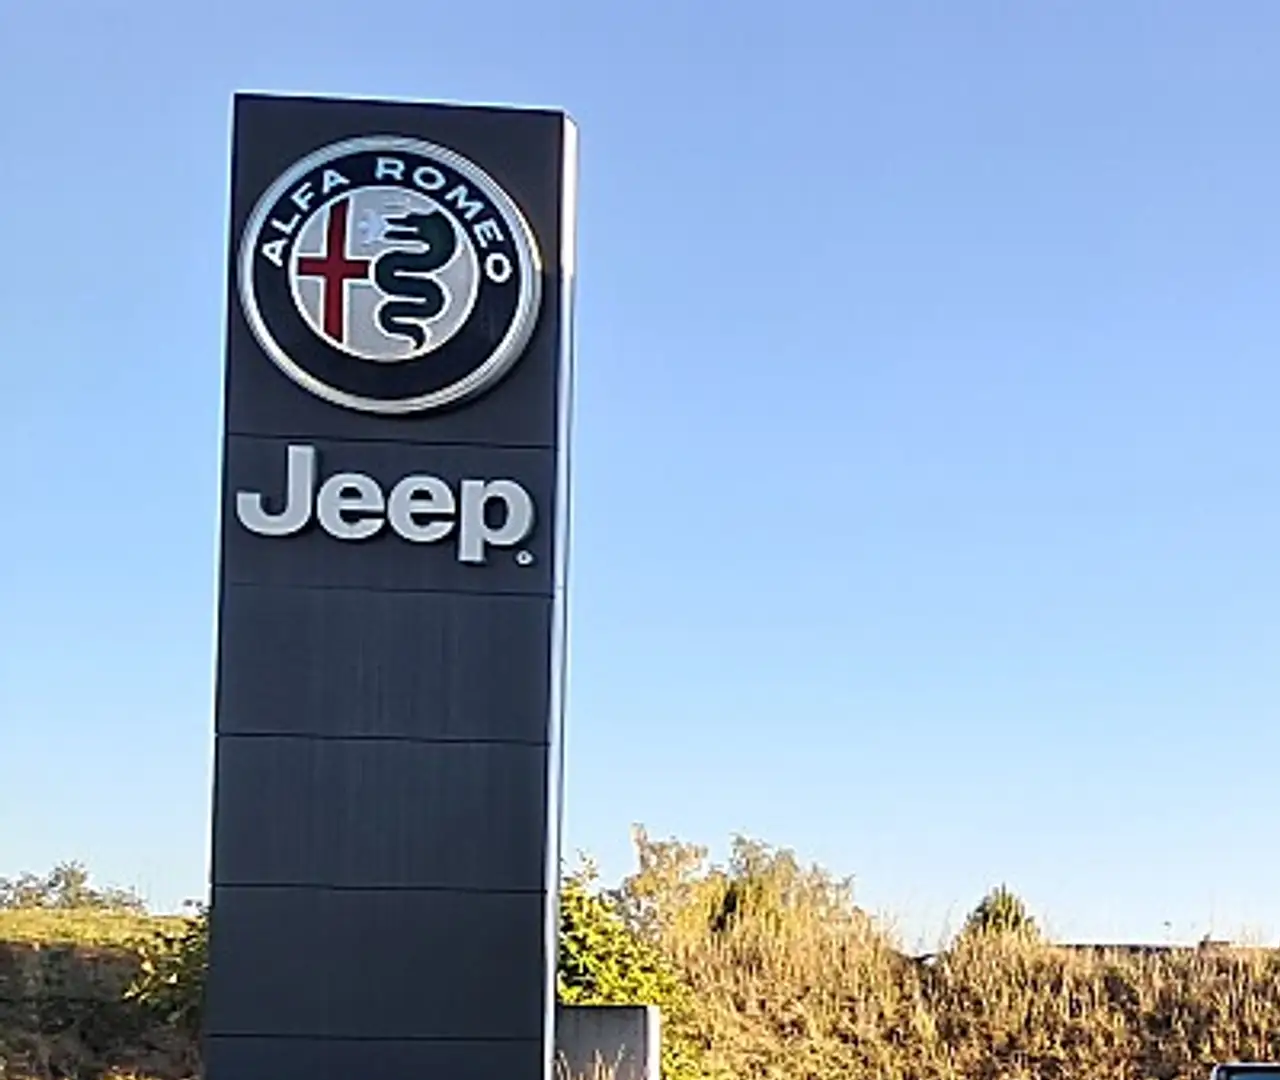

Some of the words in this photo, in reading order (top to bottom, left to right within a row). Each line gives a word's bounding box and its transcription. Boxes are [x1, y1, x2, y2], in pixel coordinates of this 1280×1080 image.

[260, 169, 351, 268] ALFA
[374, 156, 513, 284] ROMEO
[236, 444, 535, 563] Jeep
